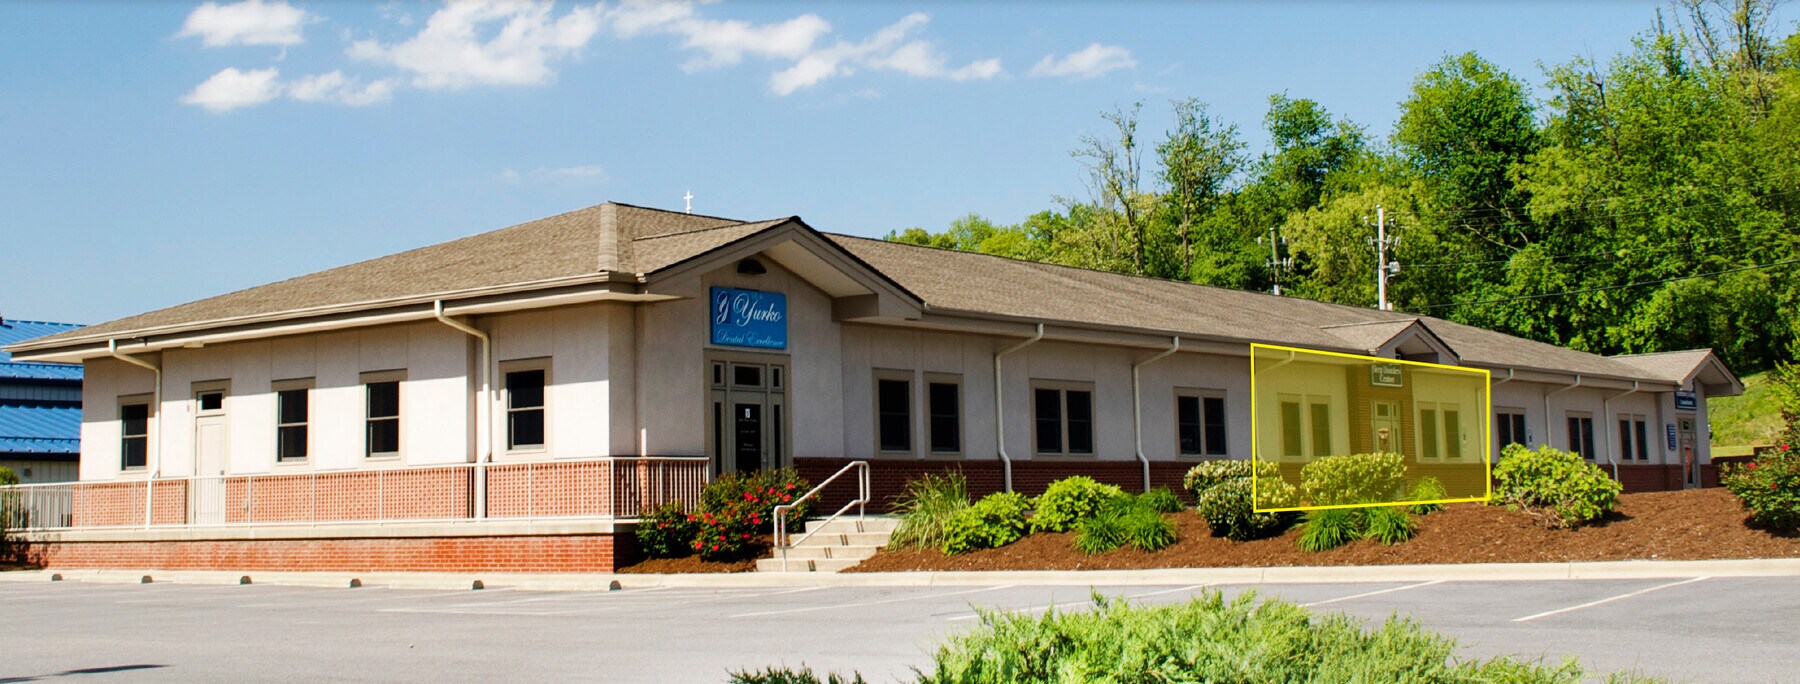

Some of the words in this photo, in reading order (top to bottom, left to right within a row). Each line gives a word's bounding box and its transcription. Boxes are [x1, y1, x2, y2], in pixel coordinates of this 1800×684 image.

[733, 293, 783, 327] Yurko
[717, 329, 745, 344] Dental
[746, 331, 784, 347] Excellence
[1379, 374, 1395, 383] Center
